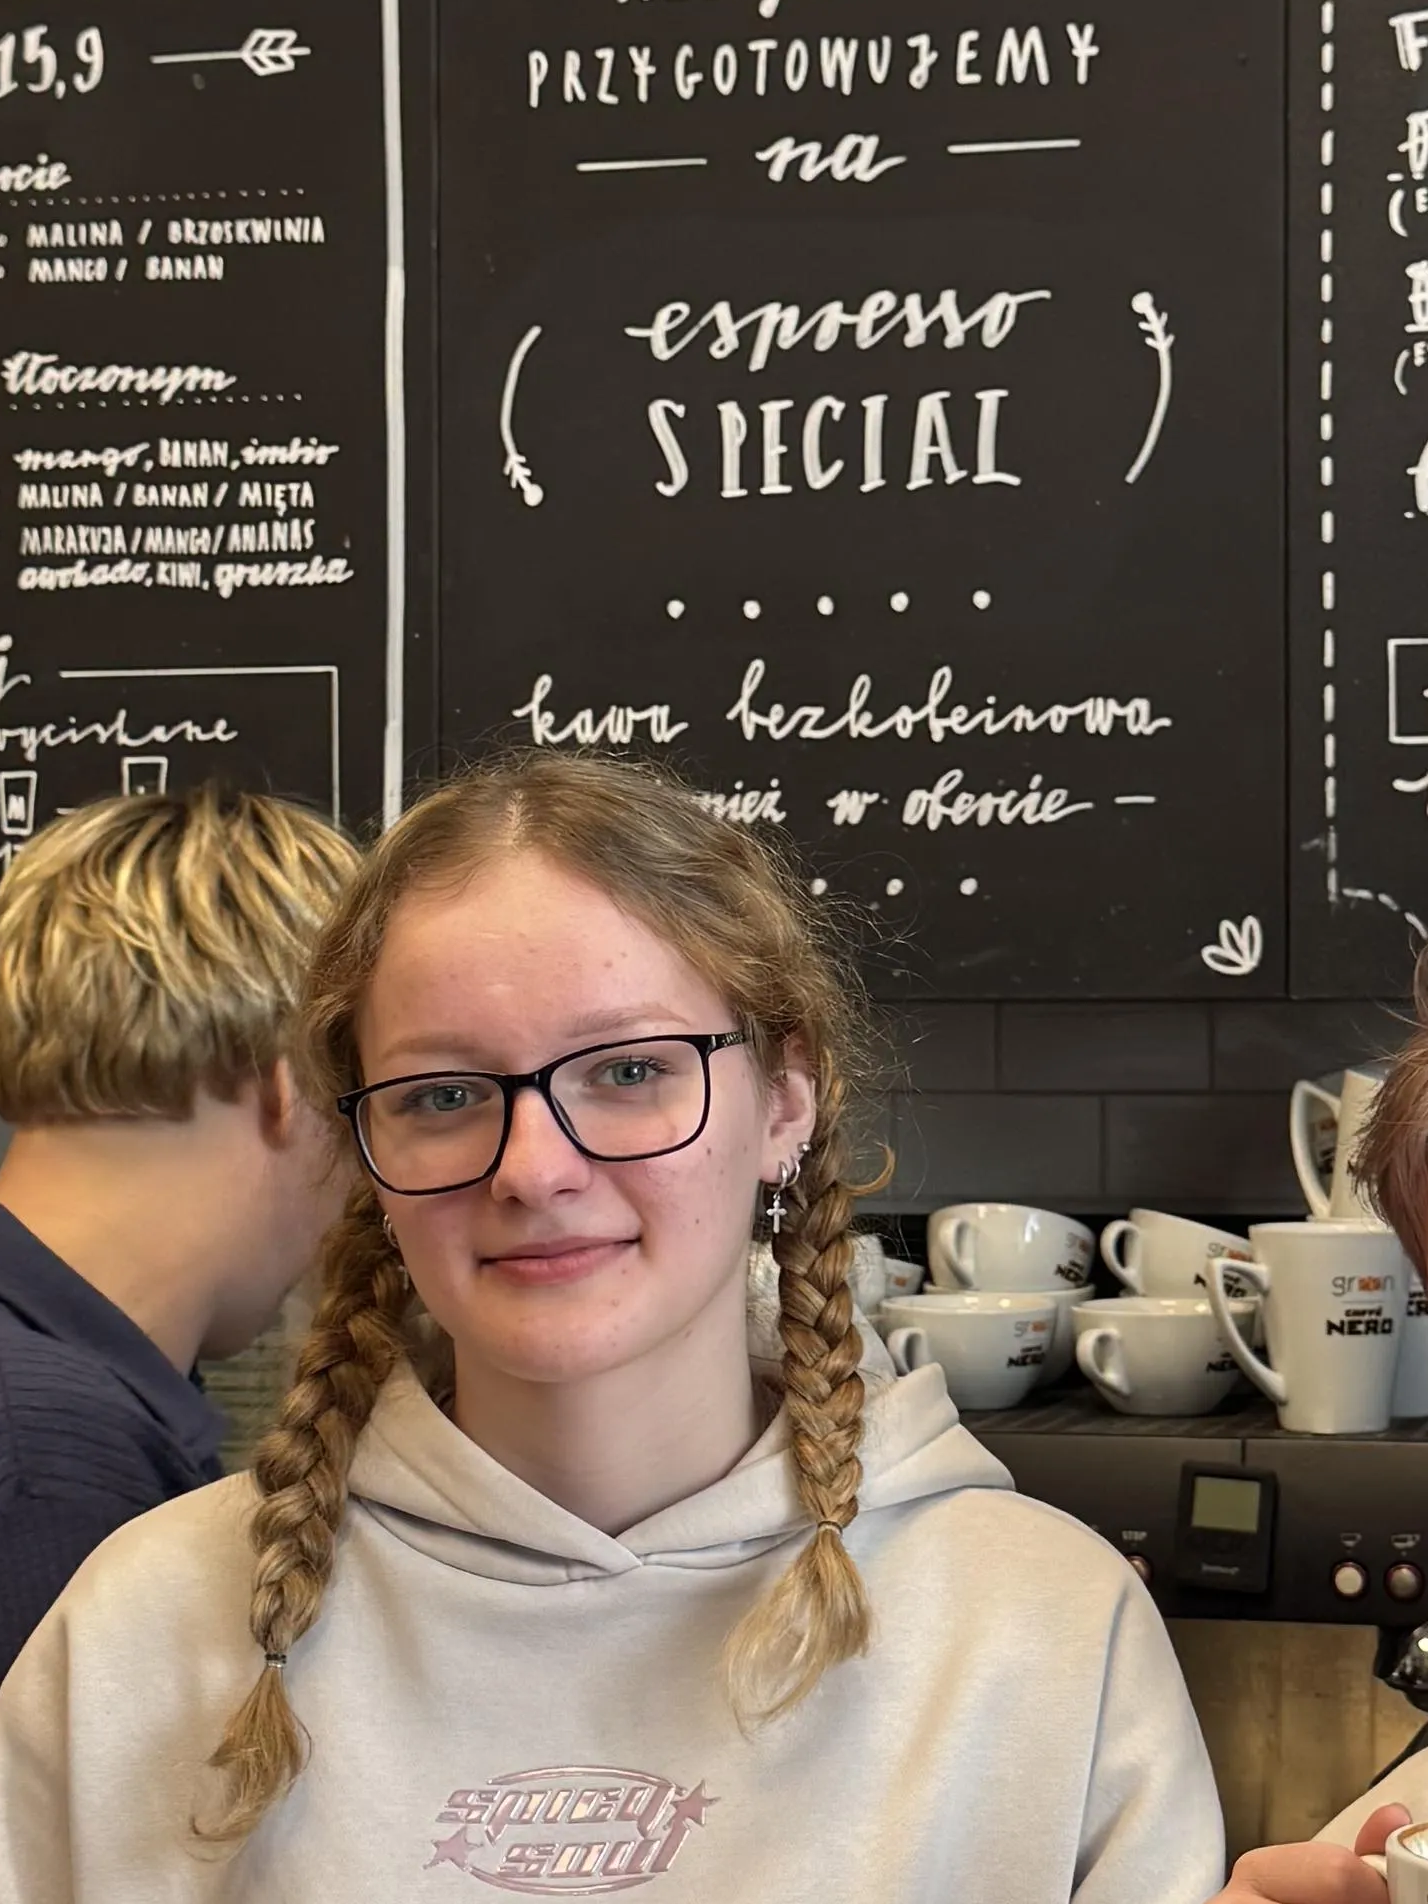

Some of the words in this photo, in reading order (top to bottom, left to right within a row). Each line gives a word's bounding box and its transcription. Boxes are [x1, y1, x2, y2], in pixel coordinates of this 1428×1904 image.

[529, 24, 1099, 107] PRZYGOTOWUJEMY
[756, 134, 906, 181] na
[27, 220, 122, 247] MALINA
[169, 217, 324, 245] BRZOSKWINIA
[29, 258, 107, 282] MANGO
[146, 255, 223, 280] BANAN
[625, 290, 1051, 371] espresso
[1, 352, 236, 405] tłoczonym
[241, 438, 339, 464] imbir
[649, 389, 1021, 497] SPECIAL
[19, 483, 103, 508] MALINA
[134, 483, 208, 507] BANAN
[239, 482, 313, 516] MIĘTA
[214, 556, 353, 598] gruszka
[513, 675, 688, 745] kawa
[726, 659, 1171, 742] bezkofeinowa
[827, 790, 879, 825] w
[903, 769, 1093, 830] ofercie
[1326, 1317, 1394, 1336] NERO
